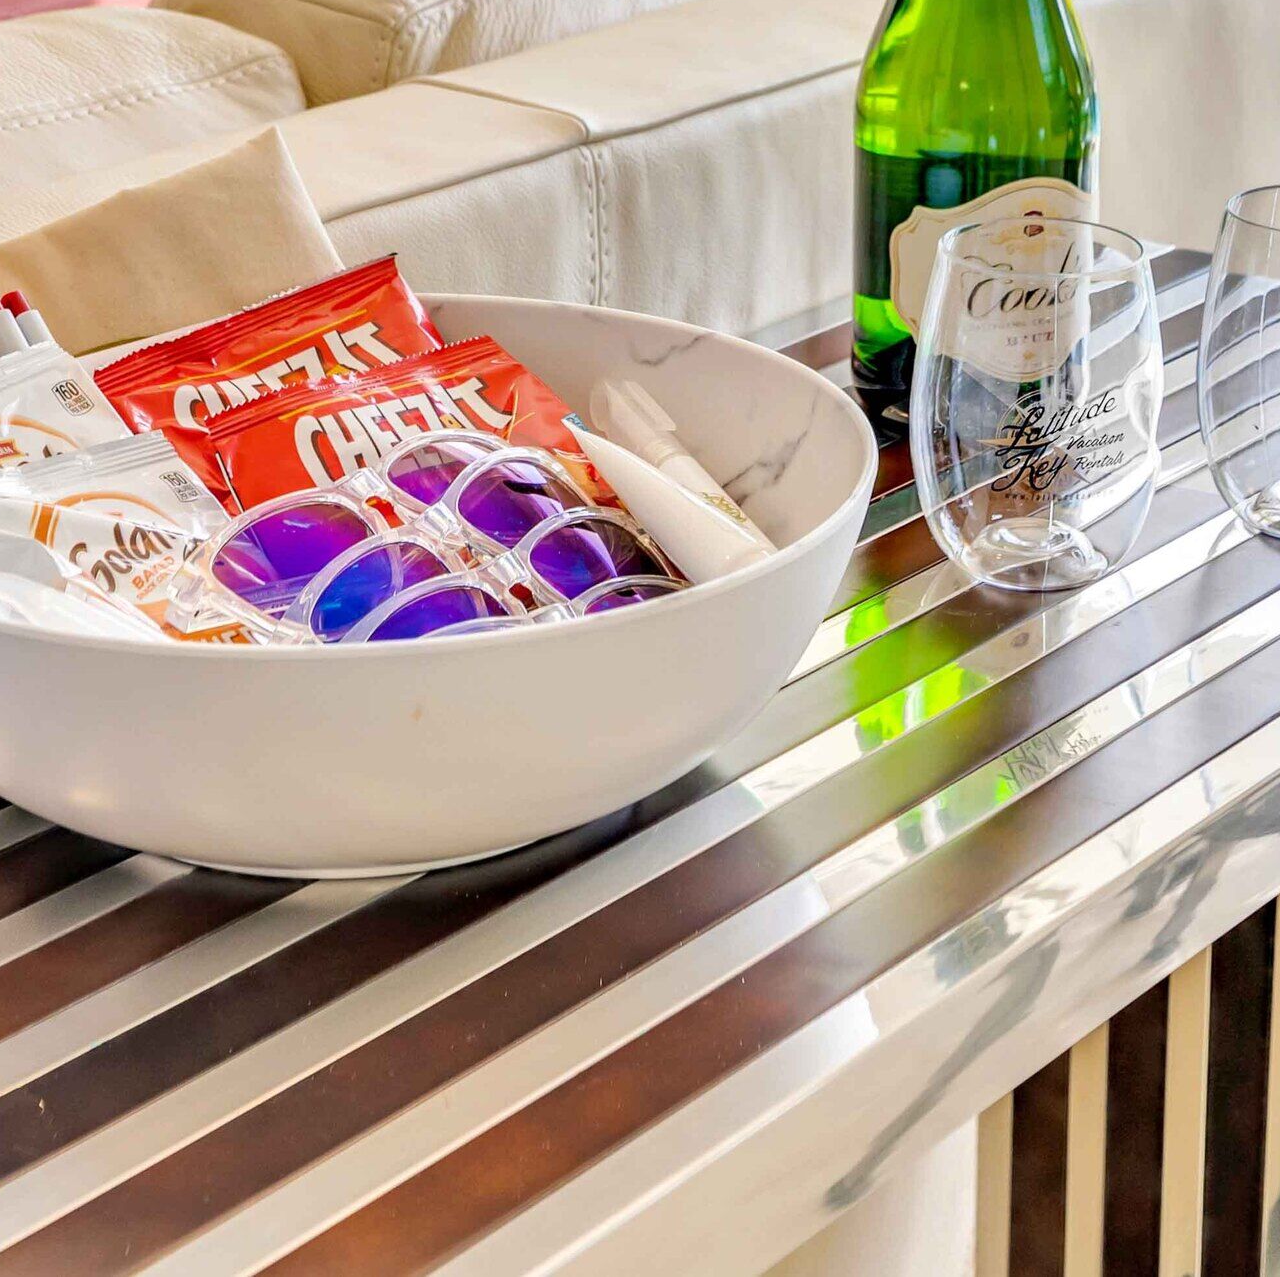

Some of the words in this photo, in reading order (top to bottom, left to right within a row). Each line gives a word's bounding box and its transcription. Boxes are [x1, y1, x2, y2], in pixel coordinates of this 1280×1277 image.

[55, 381, 80, 402] 160
[995, 390, 1118, 457] Latitude
[1067, 432, 1126, 450] Vacation
[991, 445, 1068, 492] Key
[1073, 450, 1125, 470] Rentals
